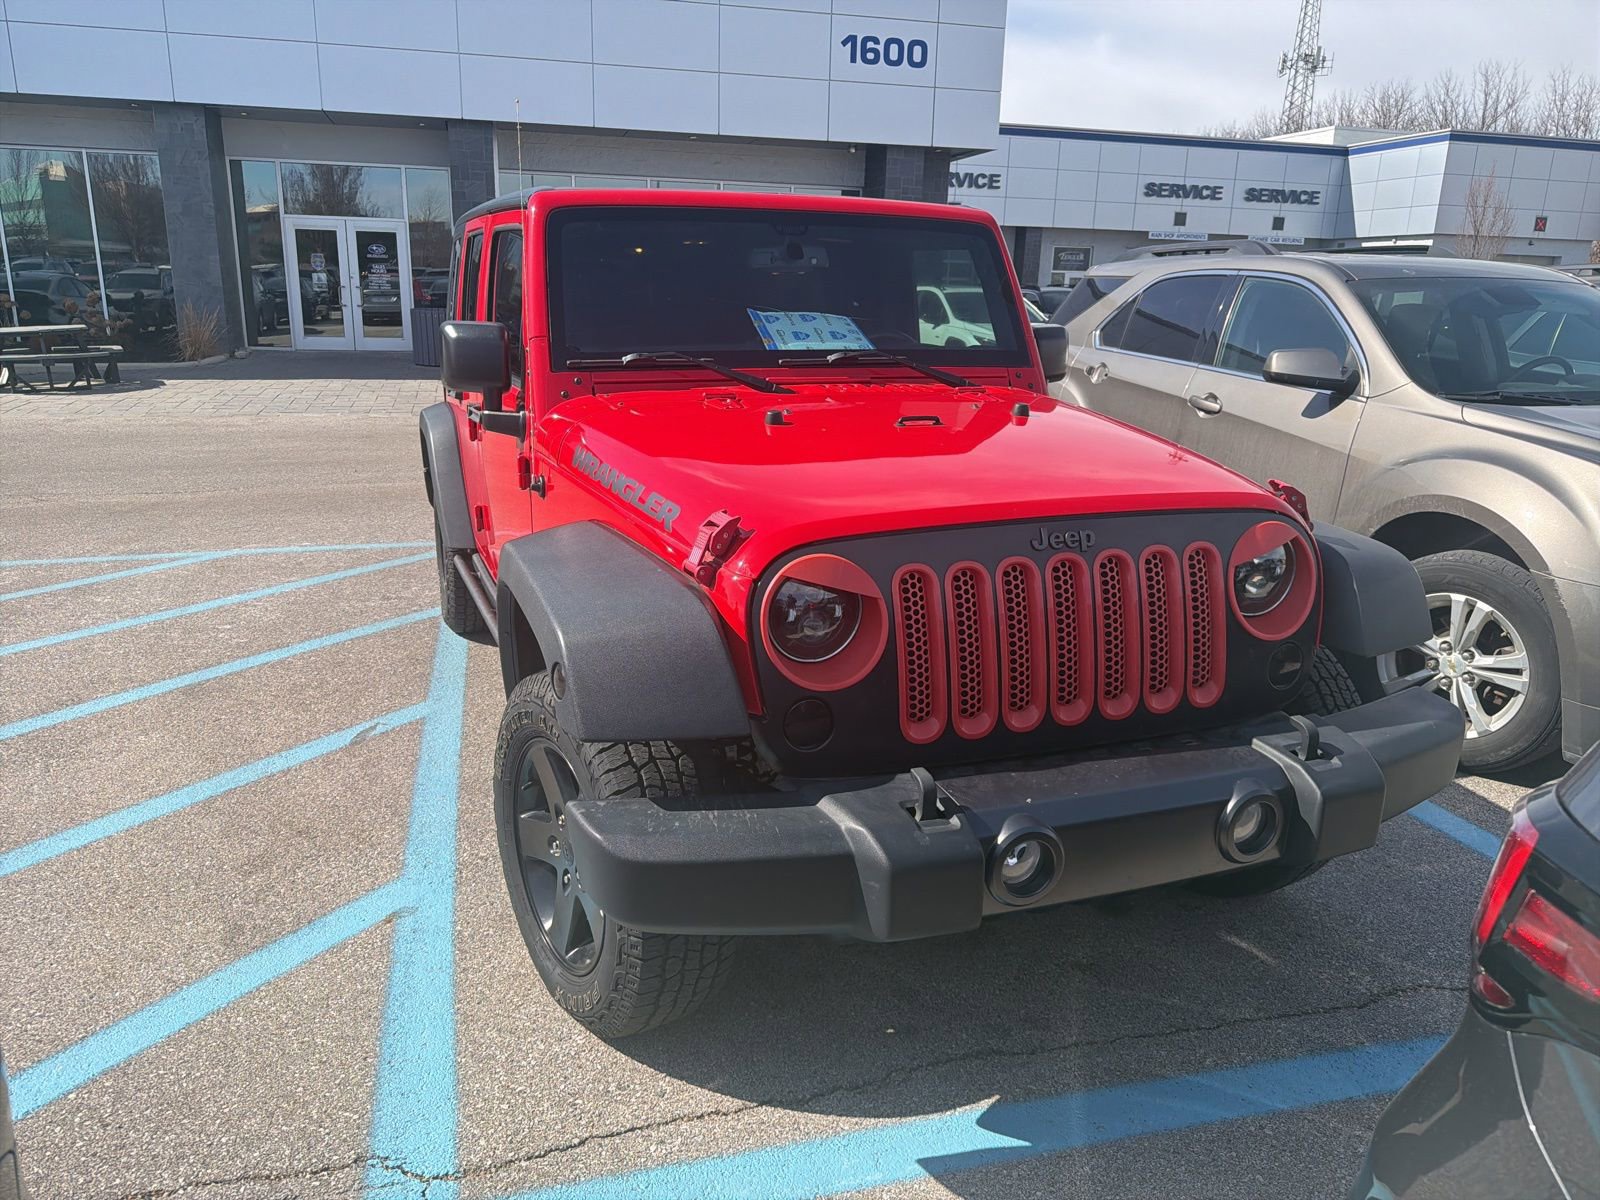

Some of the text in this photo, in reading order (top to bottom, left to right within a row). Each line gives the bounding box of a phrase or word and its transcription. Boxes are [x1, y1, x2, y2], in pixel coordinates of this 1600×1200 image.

[841, 34, 928, 68] 1600
[948, 171, 1002, 190] RVICE
[1144, 182, 1224, 201] SERVICE
[1244, 187, 1321, 206] SERVICE
[572, 444, 681, 533] WRANGLER
[1030, 527, 1096, 552] Jeep
